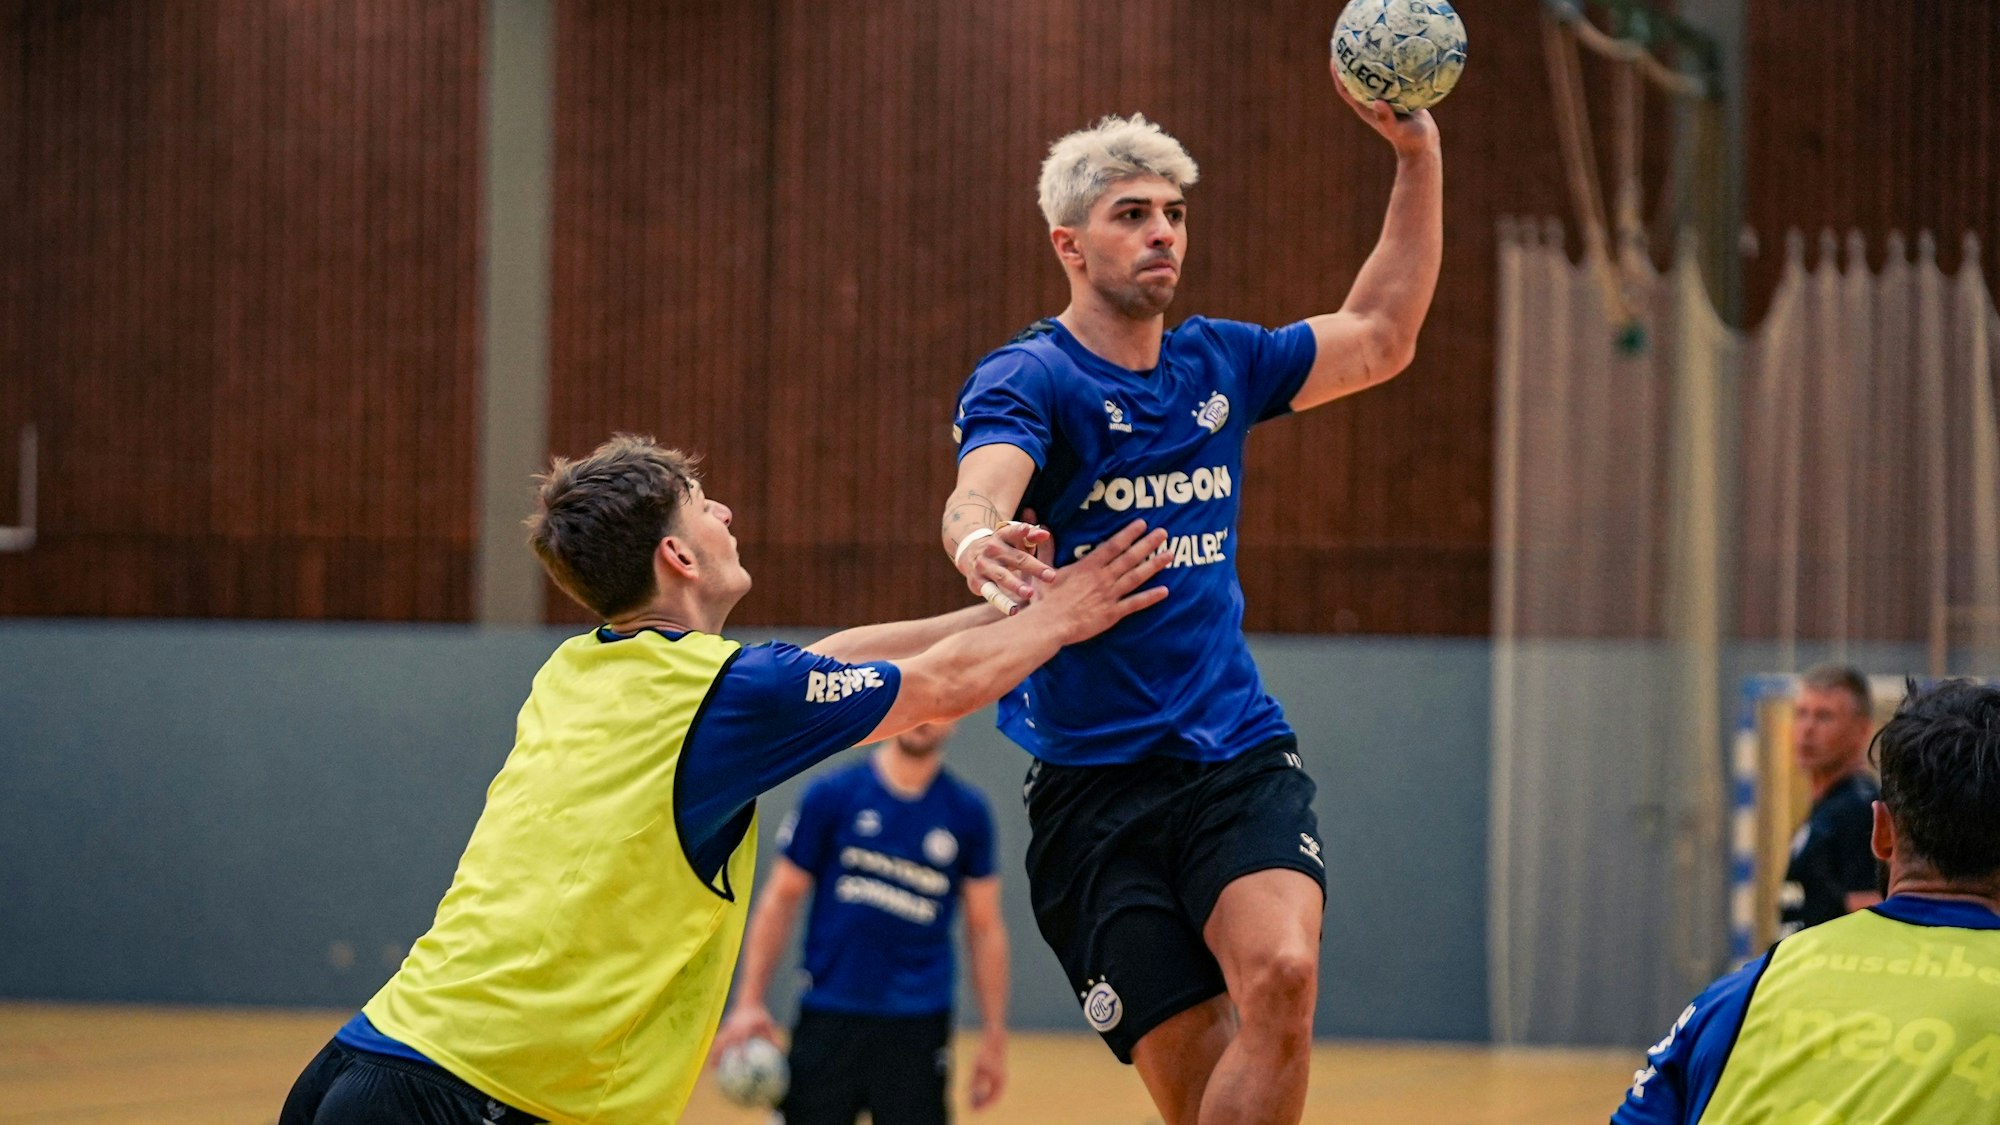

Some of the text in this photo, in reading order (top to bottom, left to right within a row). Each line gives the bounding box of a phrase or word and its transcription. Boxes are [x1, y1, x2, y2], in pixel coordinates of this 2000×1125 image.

[1336, 37, 1393, 95] SELECT
[1079, 464, 1232, 512] POLYGON
[805, 666, 884, 703] REWE
